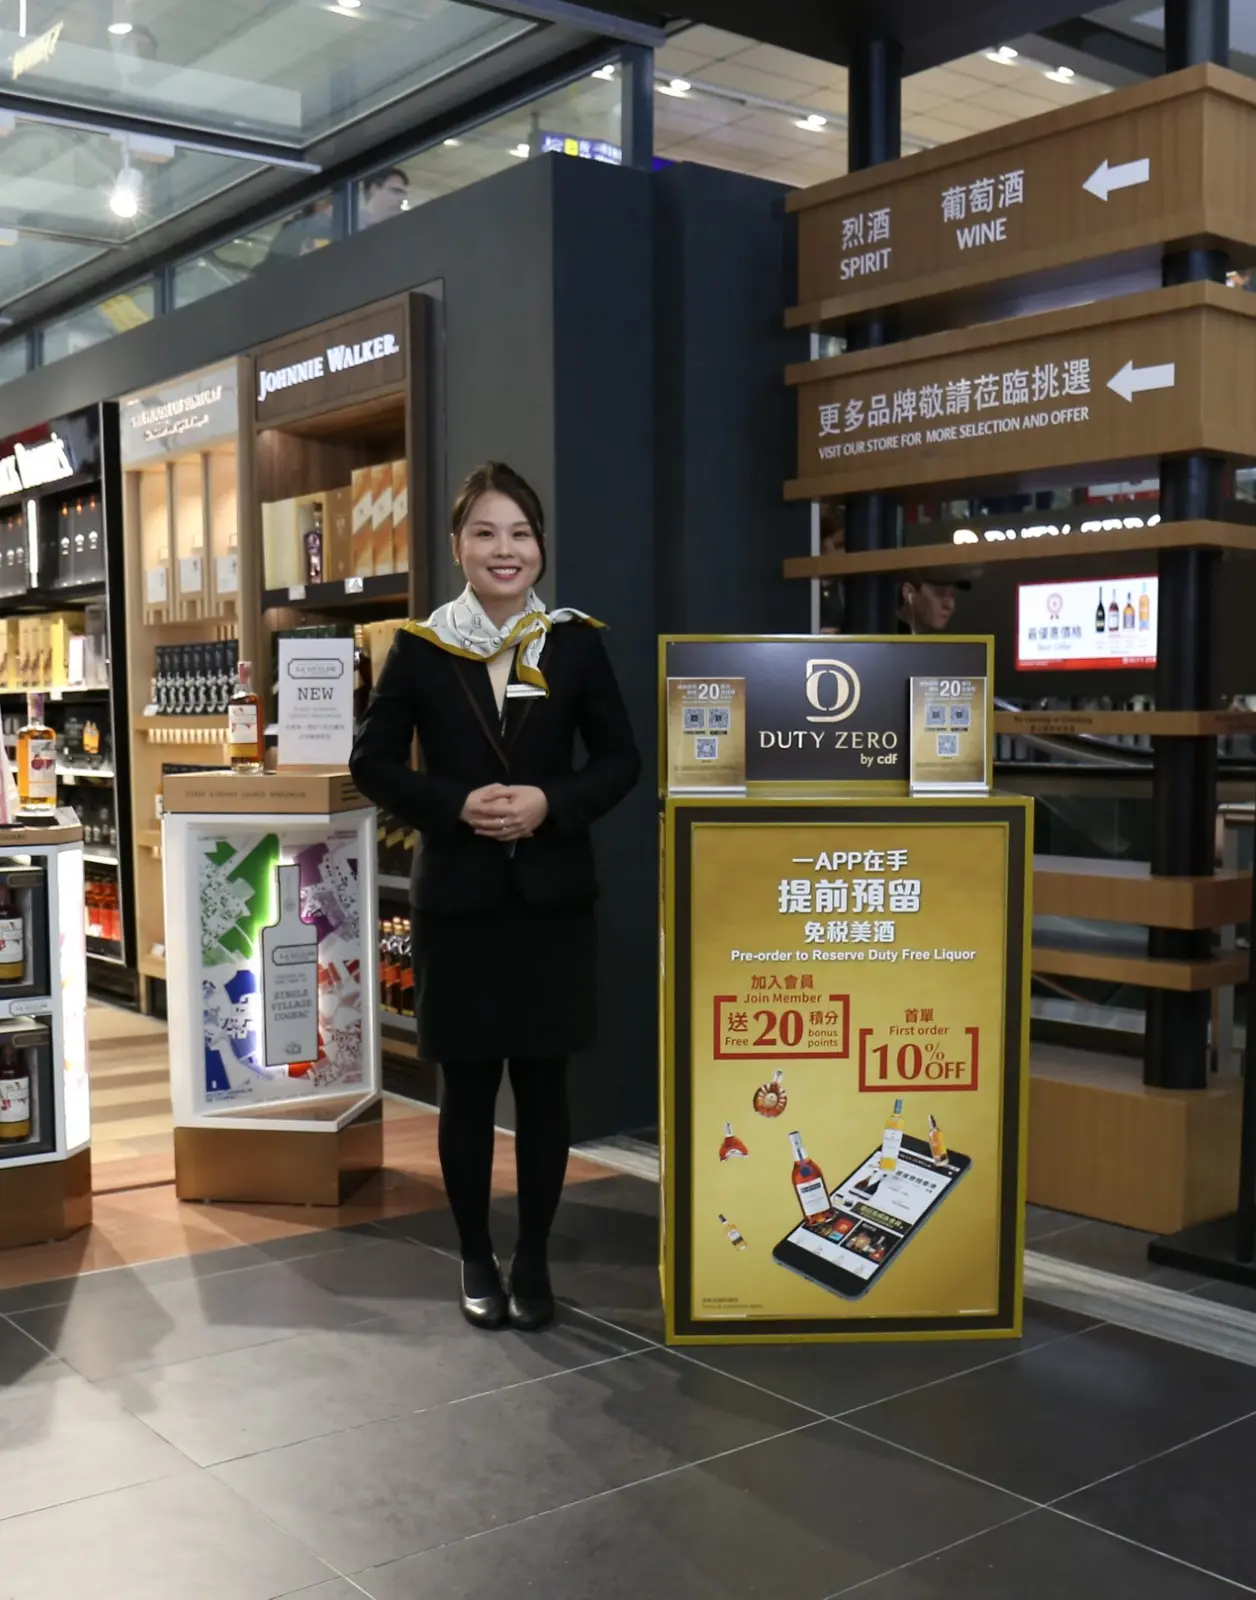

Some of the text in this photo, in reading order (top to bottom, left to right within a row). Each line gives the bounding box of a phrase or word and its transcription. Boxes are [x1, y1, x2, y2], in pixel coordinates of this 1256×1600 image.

[842, 169, 1024, 250] 烈酒 葡萄酒
[839, 217, 1007, 280] SPIRIT WINE
[257, 333, 399, 401] JOHNNIE WALKER
[818, 405, 1090, 460] VISIT OUR STORE FOR MORE SELECTION AND OFFER
[297, 687, 334, 701] NEW
[698, 683, 720, 700] 20
[939, 680, 962, 698] 20
[758, 731, 898, 749] DUTY ZERO
[860, 753, 899, 768] by cdf
[778, 879, 921, 913] 提前預留
[731, 948, 976, 963] Pre-order to Reserve Duty Free Liquor
[751, 974, 814, 990] 加入會員
[743, 993, 822, 1004] Join Member
[904, 1008, 934, 1023] 首單
[727, 1009, 839, 1047] 送 20 積分
[808, 1029, 838, 1037] bonus
[889, 1025, 949, 1036] First order
[725, 1037, 749, 1046] Free
[807, 1037, 838, 1048] points
[924, 1061, 967, 1080] OFF
